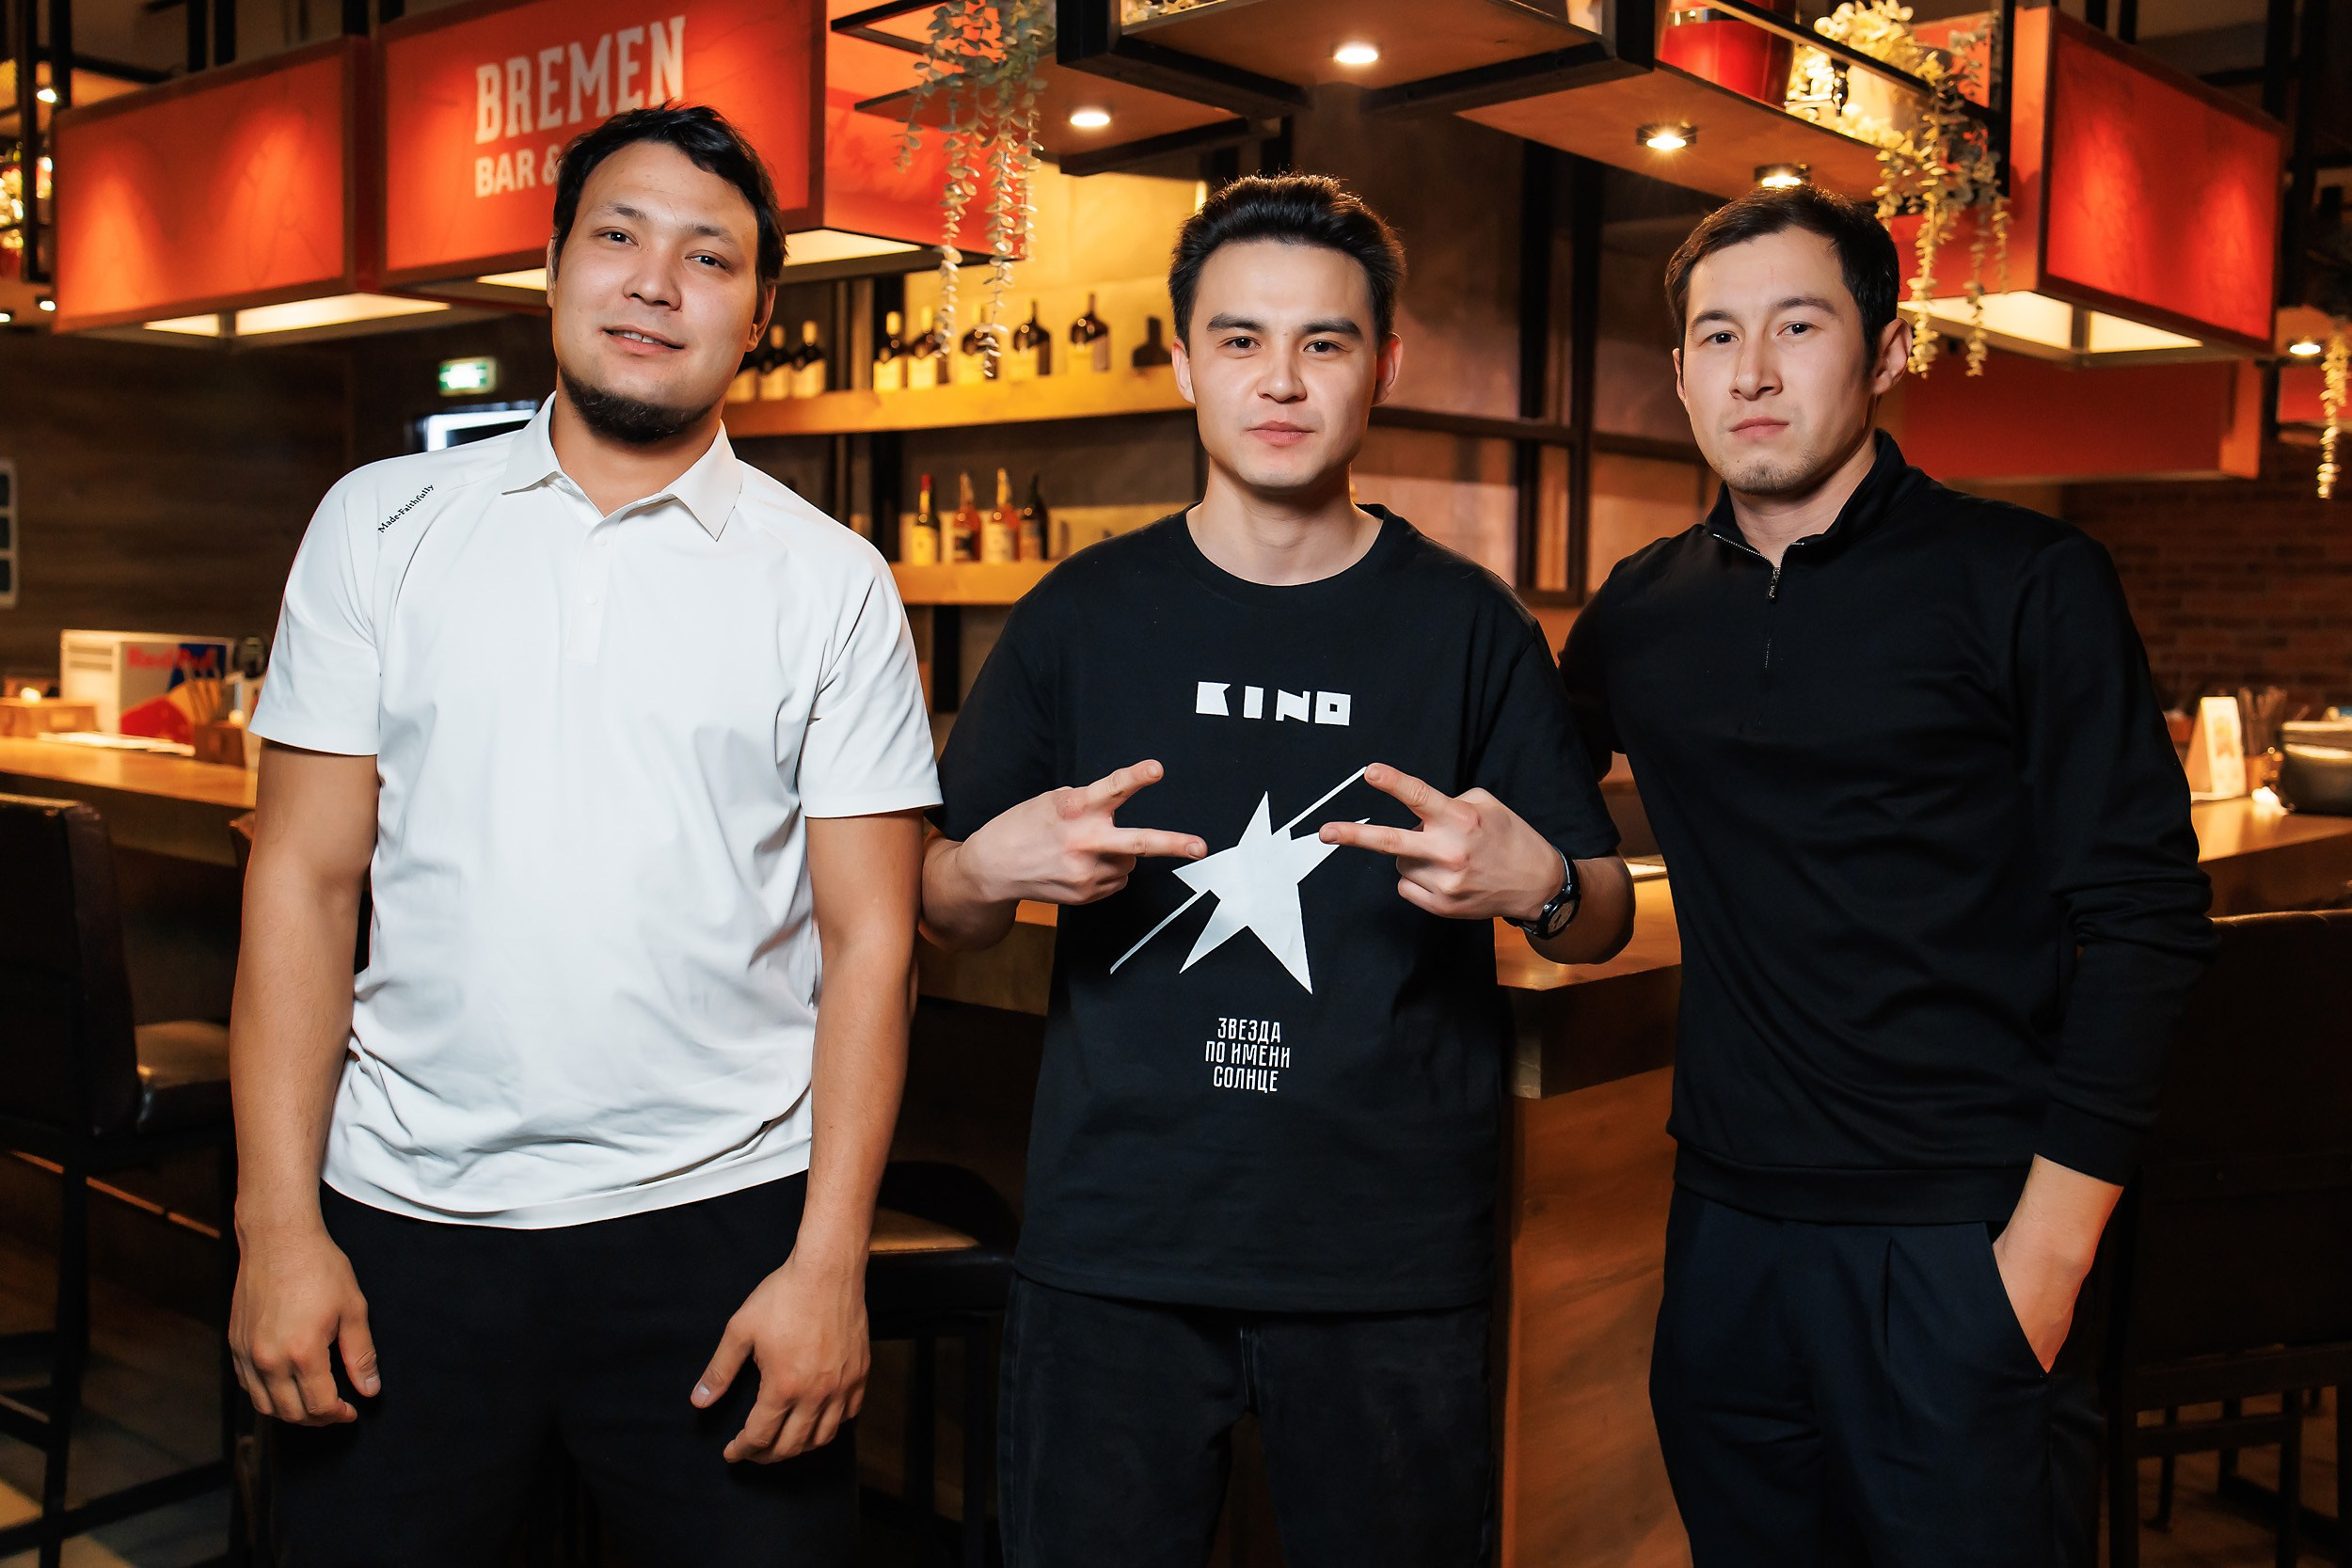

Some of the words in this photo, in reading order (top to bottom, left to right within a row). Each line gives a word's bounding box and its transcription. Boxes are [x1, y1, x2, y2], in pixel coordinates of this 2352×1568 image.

[475, 15, 686, 145] BREMEN
[475, 148, 535, 198] BAR
[377, 484, 435, 533] Made-Faithfully
[1195, 681, 1352, 726] KINO
[1217, 1017, 1280, 1045] ЗВЕЗДА
[1205, 1040, 1226, 1064] ПО
[1231, 1042, 1291, 1069] ИМЕНИ
[1213, 1065, 1279, 1094] СОЛНЦЕ
